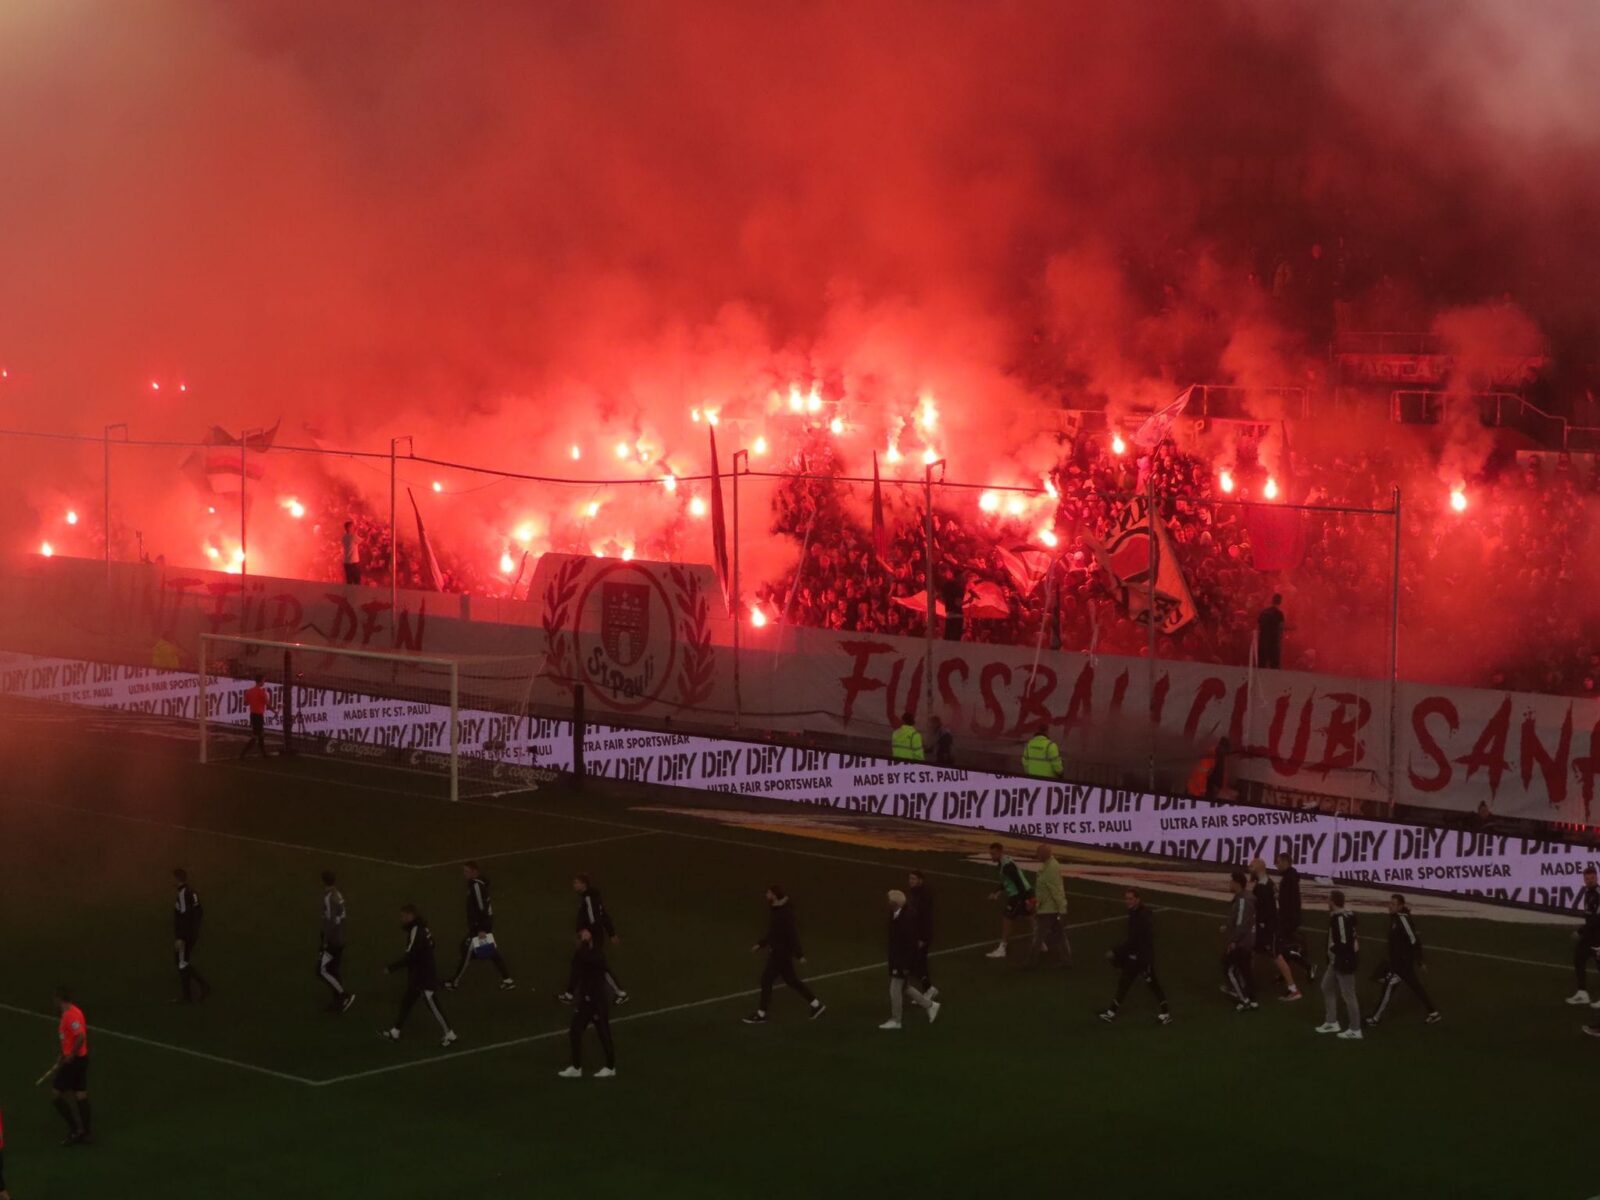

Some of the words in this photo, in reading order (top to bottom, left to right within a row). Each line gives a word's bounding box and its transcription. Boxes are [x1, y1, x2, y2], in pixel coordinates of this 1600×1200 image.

[93, 688, 113, 698] PAULI
[128, 683, 150, 695] ULTRA
[152, 681, 168, 692] FAIR
[344, 709, 367, 721] MADE
[369, 708, 381, 718] BY
[382, 707, 392, 717] FC
[393, 707, 405, 717] ST.
[407, 704, 431, 715] PAULI
[513, 747, 525, 758] ST.
[603, 738, 625, 750] FAIR
[626, 734, 690, 748] SPORTSWEAR
[740, 781, 761, 793] FAIR
[764, 776, 832, 791] SPORTSWEAR
[853, 774, 884, 786] MADE
[888, 773, 900, 784] BY
[904, 772, 916, 783] FC
[919, 771, 934, 782] ST.
[937, 769, 968, 782] PAULI
[1009, 823, 1042, 836] MADE
[1045, 822, 1060, 834] BY
[1064, 822, 1076, 833] FC
[1079, 821, 1095, 833] ST.
[1099, 820, 1132, 832] PAULI
[1161, 817, 1198, 830] ULTRA
[1202, 815, 1229, 828] FAIR
[1232, 812, 1318, 827] SPORTSWEAR
[1384, 868, 1414, 881] FAIR
[1418, 864, 1512, 880] SPORTSWEAR
[1541, 862, 1583, 876] MADE
